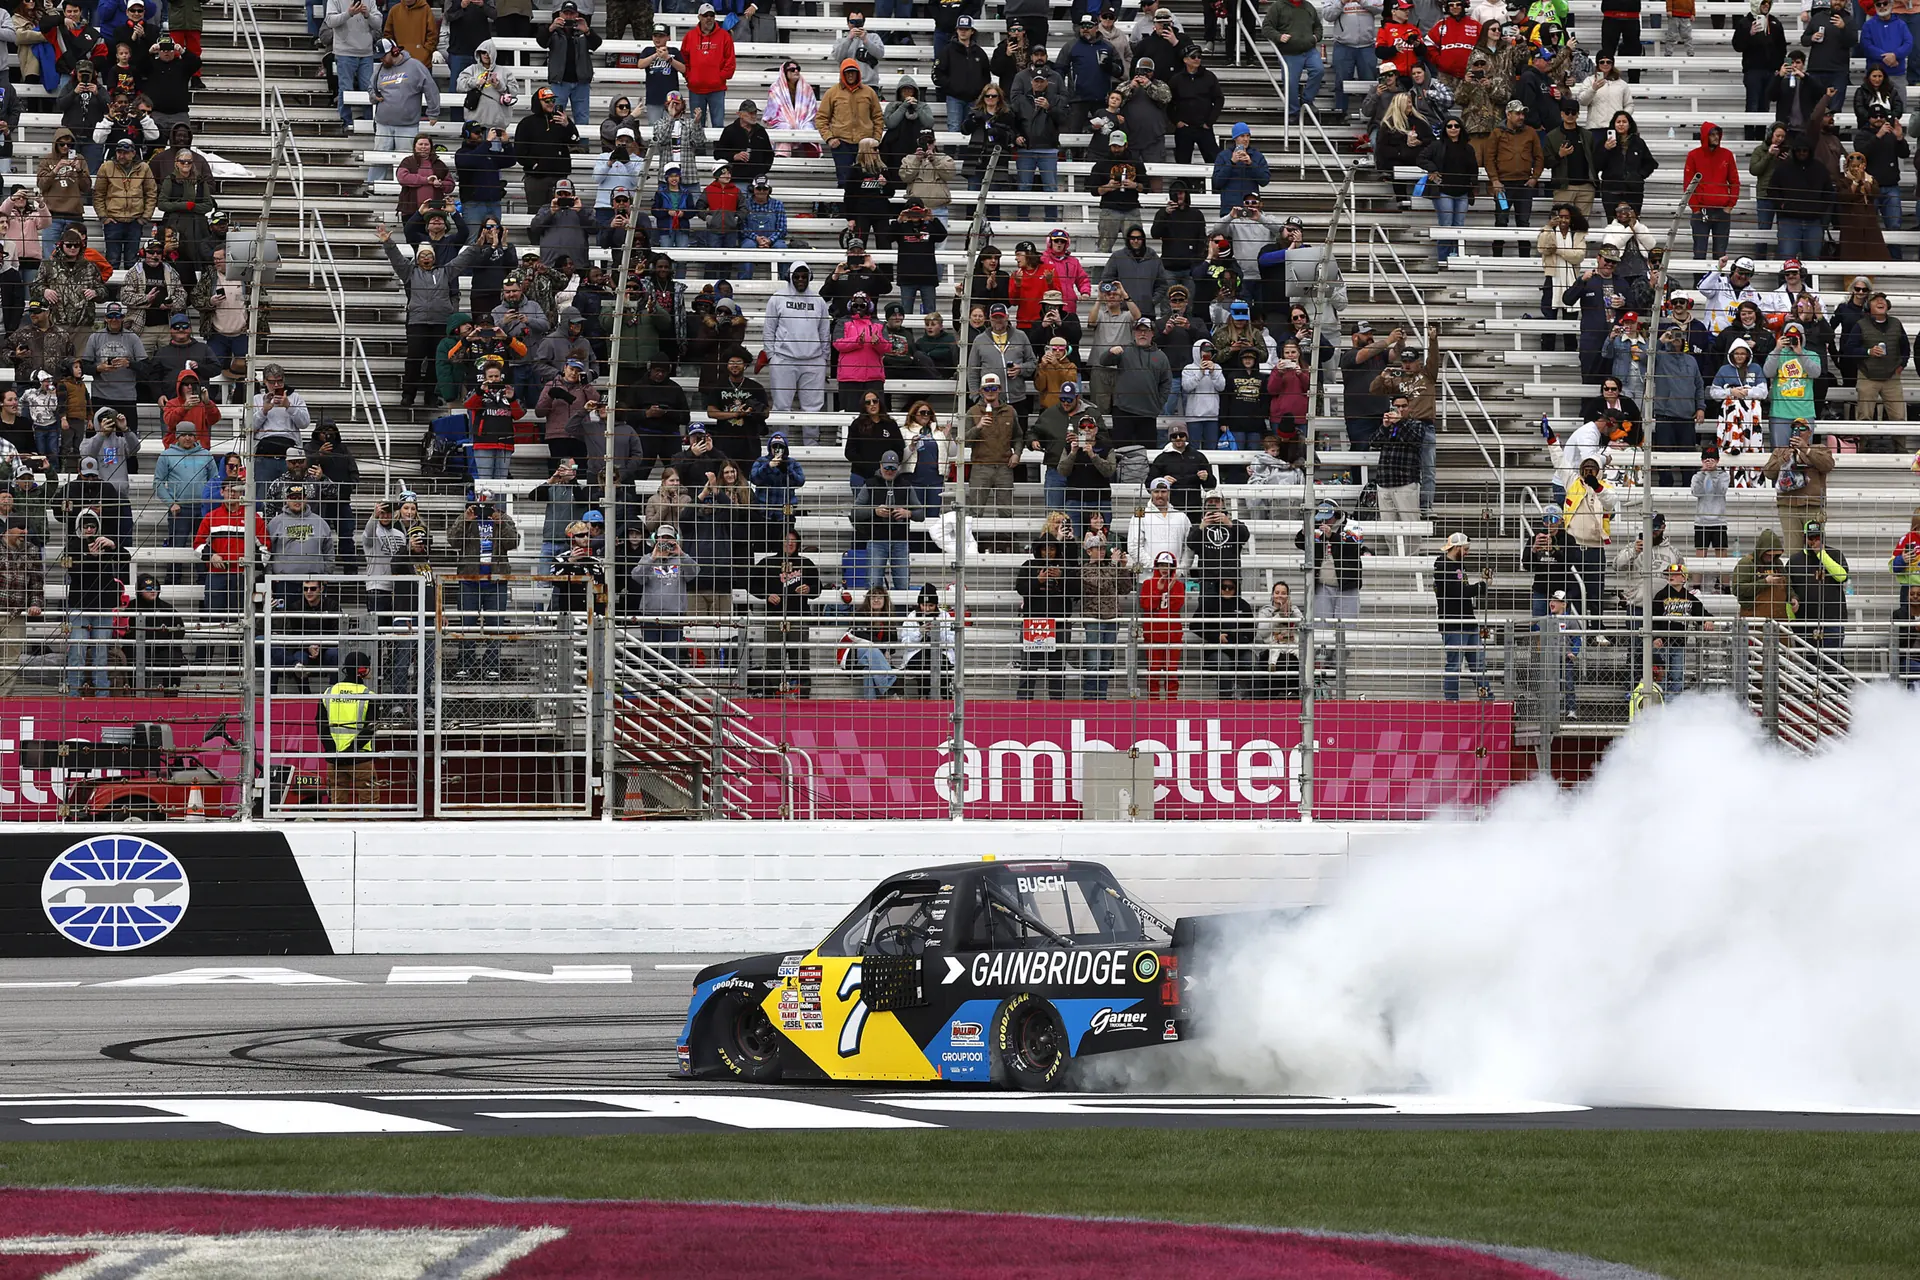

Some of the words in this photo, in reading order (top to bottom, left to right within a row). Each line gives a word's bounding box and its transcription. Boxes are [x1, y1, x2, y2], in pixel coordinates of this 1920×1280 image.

[1017, 875, 1067, 893] BUSCH
[1122, 897, 1168, 931] CHEVROLET
[971, 950, 1129, 986] GAINBRIDGE
[712, 978, 755, 992] GOODYEAR
[778, 1002, 799, 1010] CALICO
[783, 1020, 802, 1028] JESEL
[1000, 993, 1029, 1050] GOODYEAR
[1091, 1008, 1147, 1035] Garner
[718, 1047, 743, 1075] EAGLE
[942, 1052, 983, 1061] GROUP1001
[1044, 1049, 1062, 1083] EAGLE
